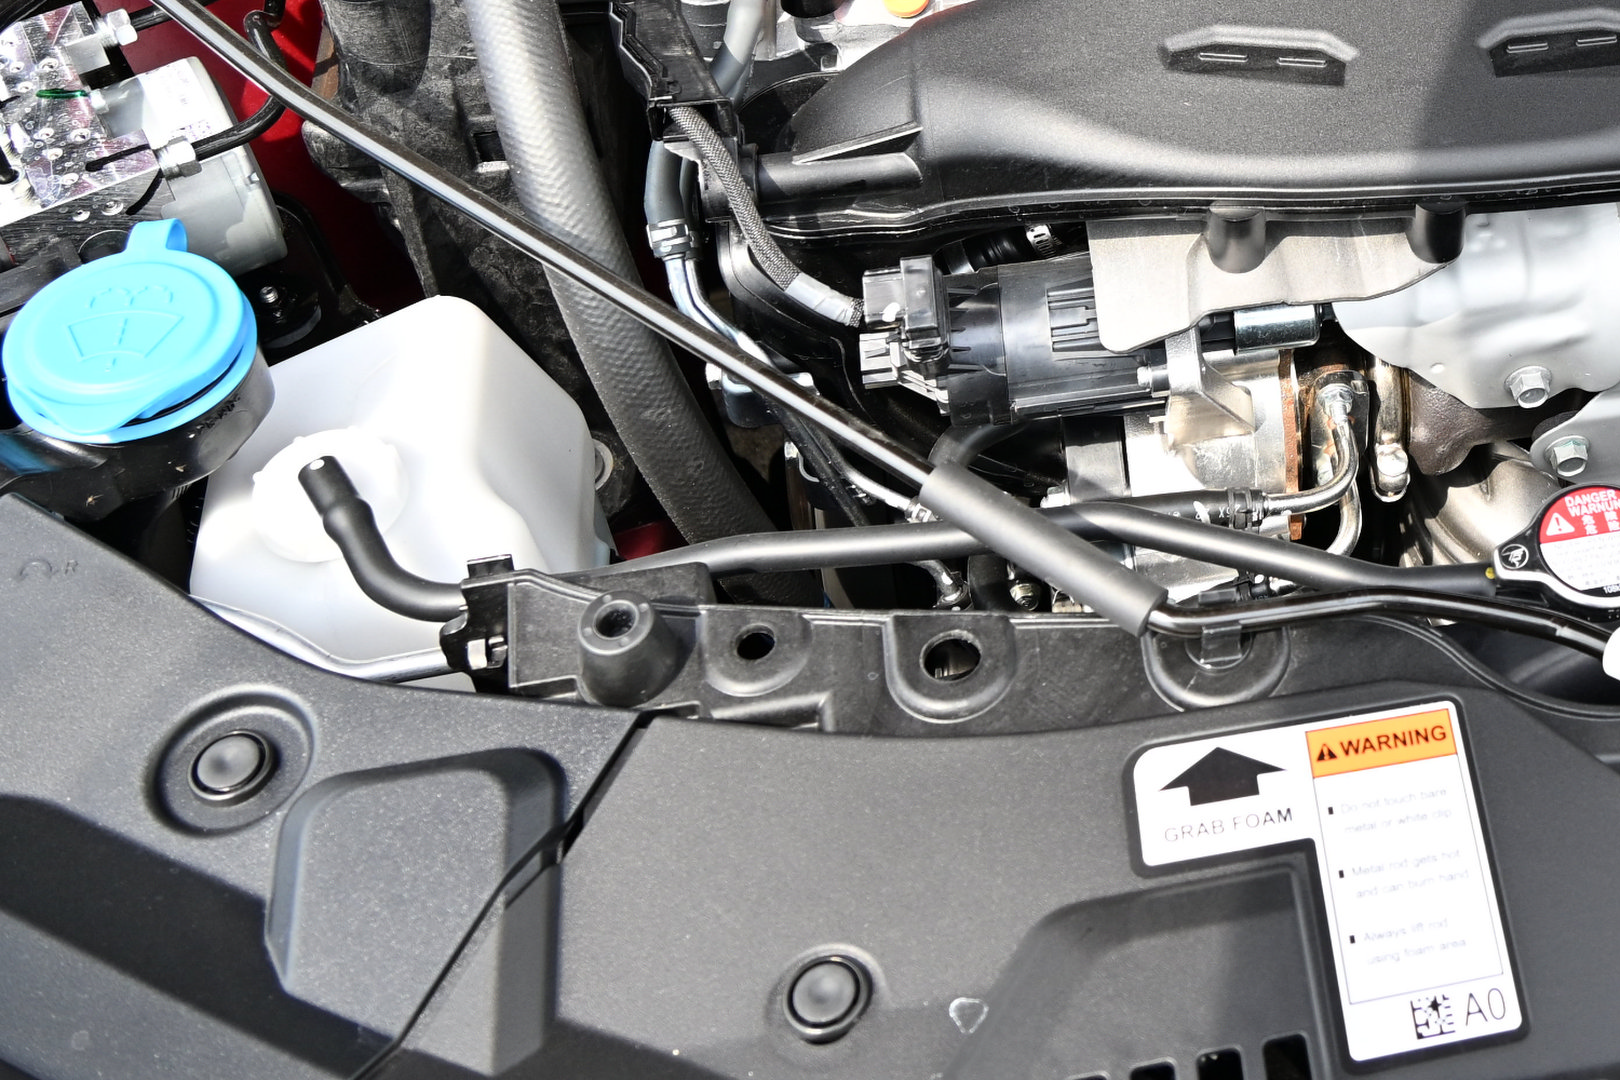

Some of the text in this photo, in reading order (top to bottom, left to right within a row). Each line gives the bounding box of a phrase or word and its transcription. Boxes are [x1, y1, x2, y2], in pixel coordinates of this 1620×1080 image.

[1564, 489, 1616, 507] DANGER
[1339, 724, 1447, 757] WARNING
[1340, 787, 1447, 814] Do not touch bare
[1164, 807, 1294, 844] GRAB FOAM
[1344, 808, 1452, 834] metal or white clip
[1352, 849, 1461, 876] Metal rod gets hot
[1355, 870, 1469, 898] and can burn hand
[1363, 918, 1448, 944] Always lift rod
[1366, 938, 1467, 966] using foam area
[1464, 987, 1507, 1027] A0
